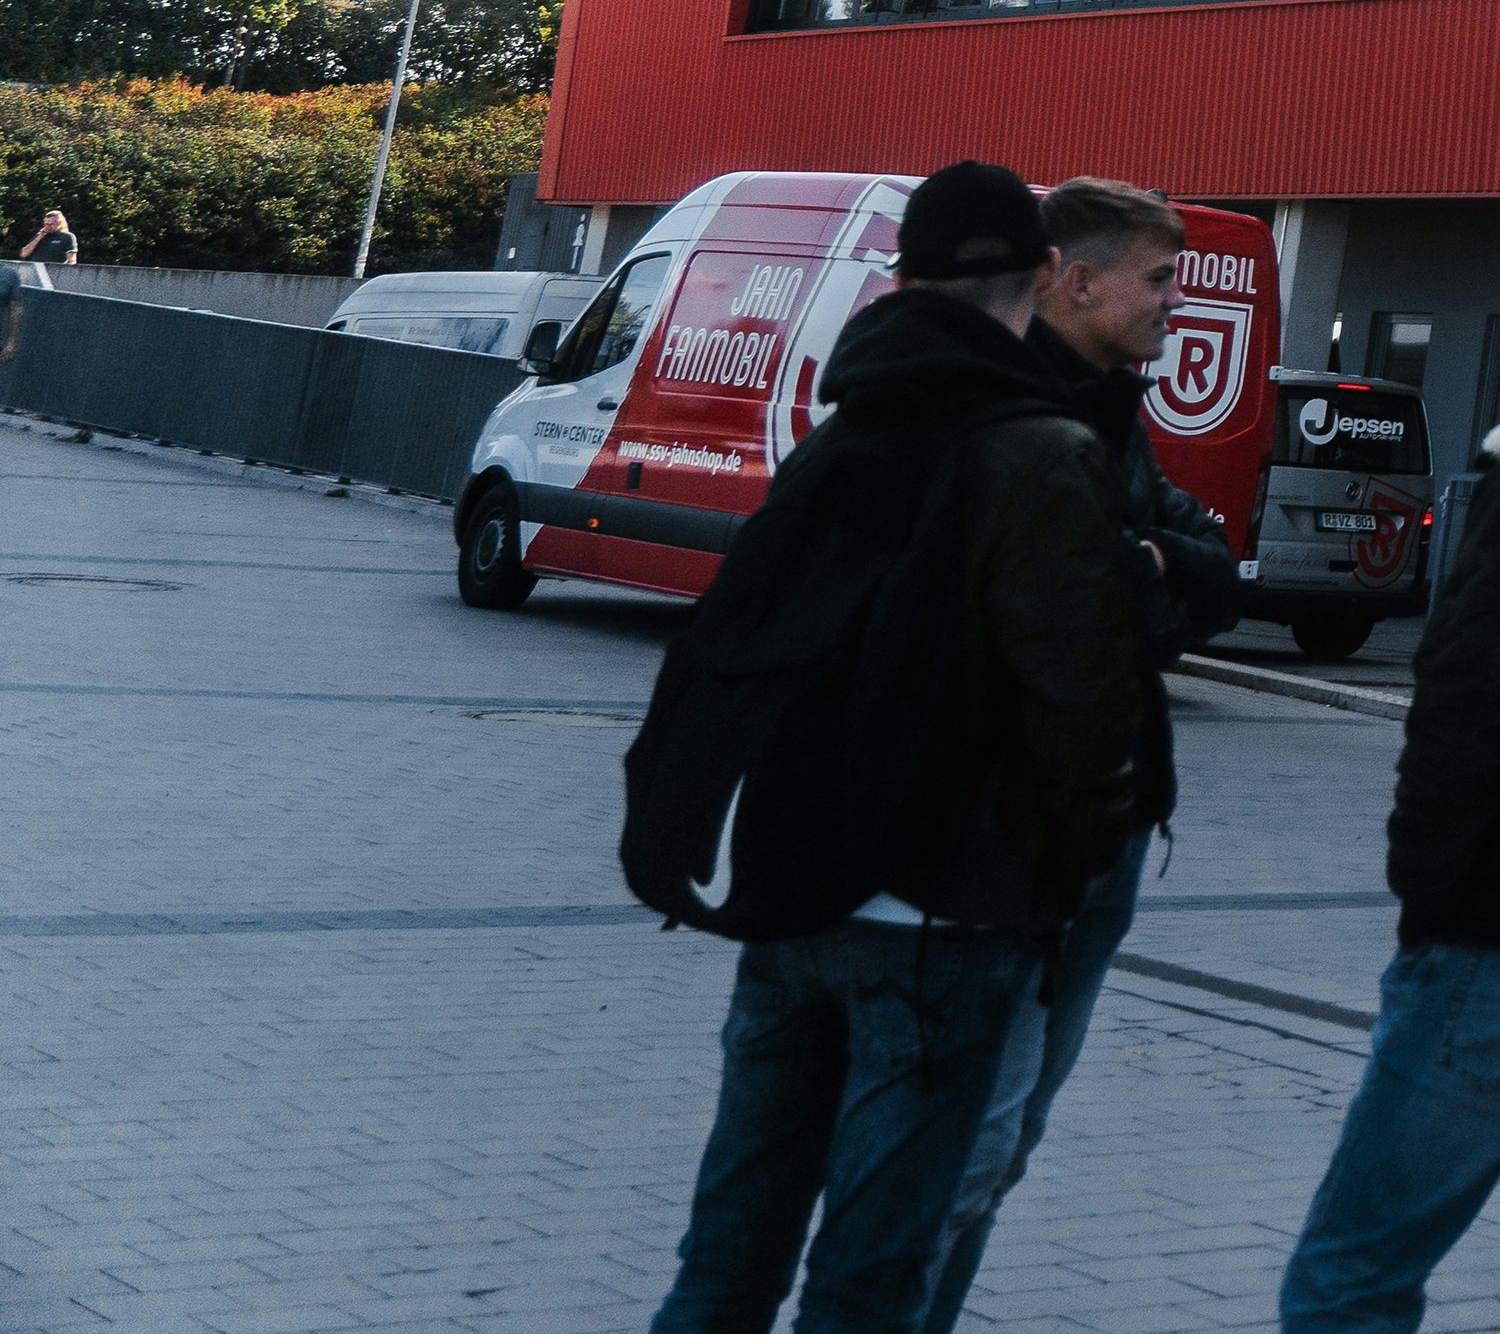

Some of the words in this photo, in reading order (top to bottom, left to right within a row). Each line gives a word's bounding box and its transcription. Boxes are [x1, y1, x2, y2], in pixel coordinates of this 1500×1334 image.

[1176, 250, 1257, 294] MOBIL
[731, 264, 803, 321] JAHN
[655, 324, 777, 389] FANMOBIL
[534, 421, 563, 440] STERN
[569, 426, 605, 445] CENTER
[618, 440, 742, 476] www.ssv-jahnshop.de
[1355, 516, 1375, 529] 801
